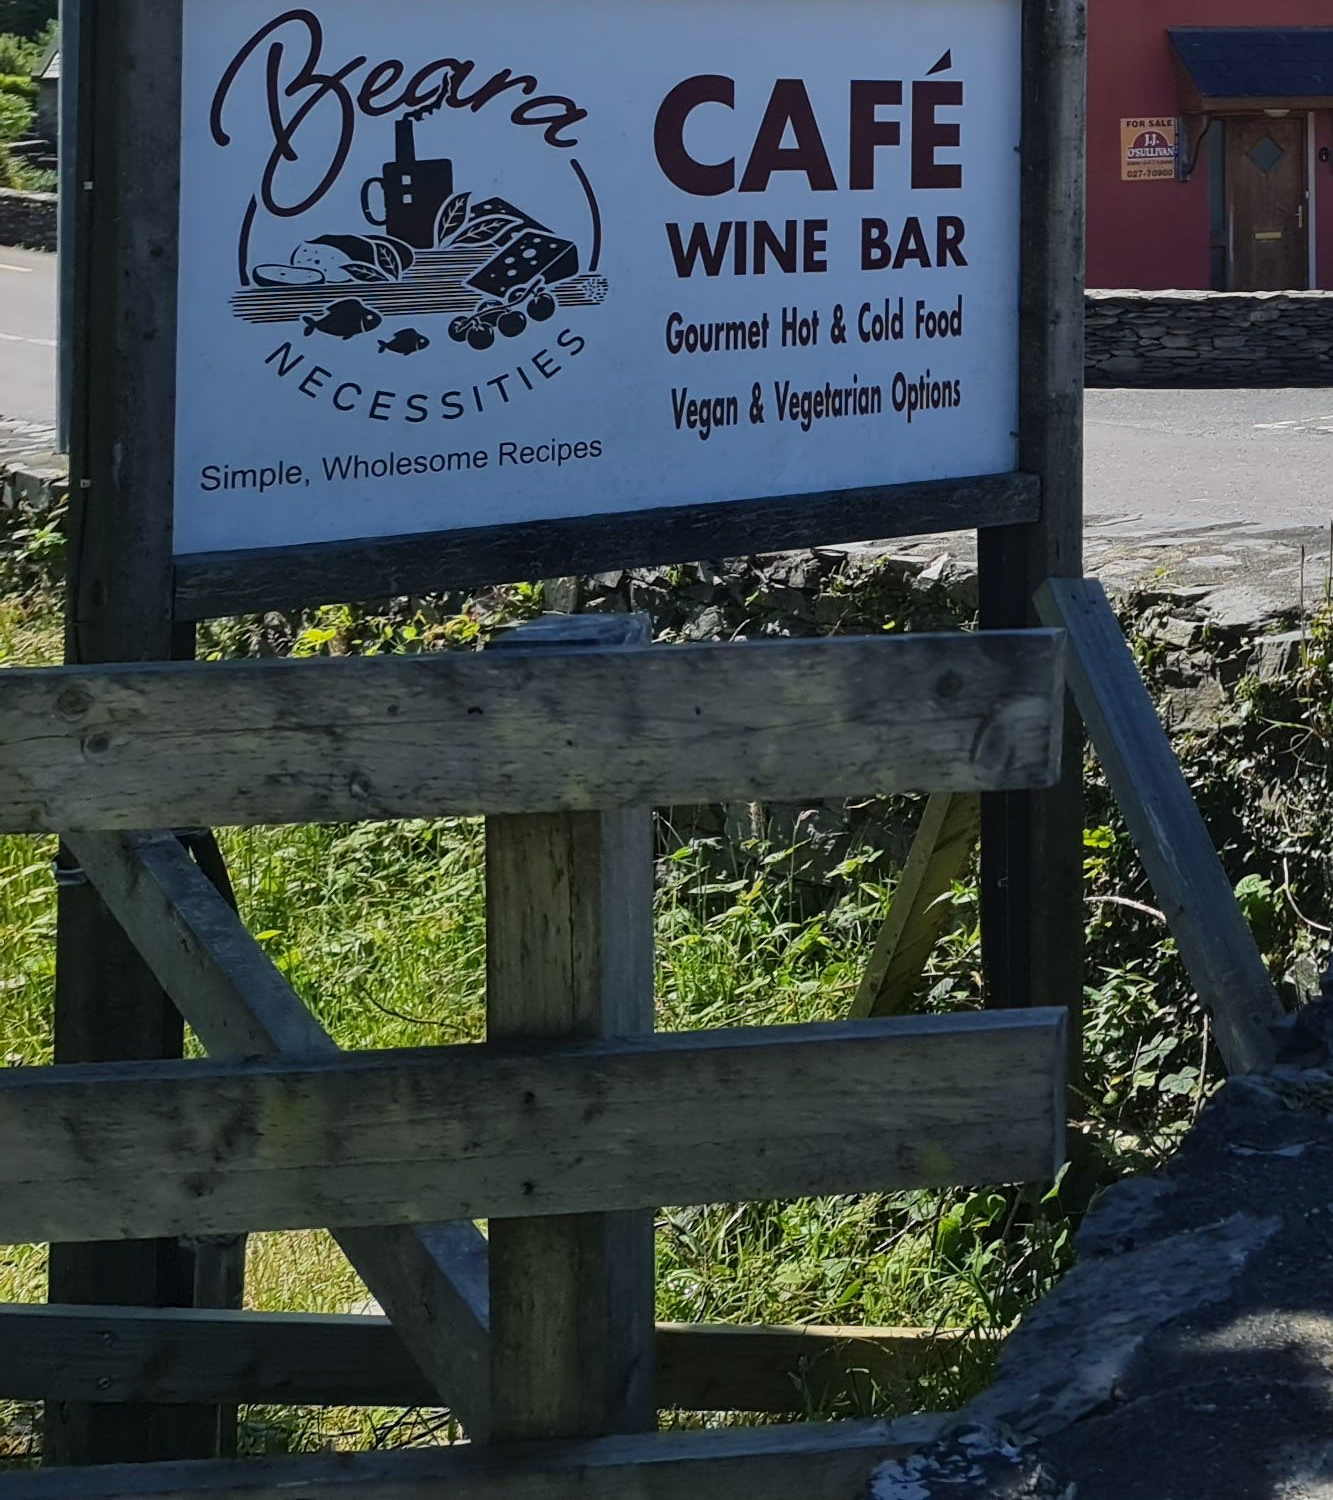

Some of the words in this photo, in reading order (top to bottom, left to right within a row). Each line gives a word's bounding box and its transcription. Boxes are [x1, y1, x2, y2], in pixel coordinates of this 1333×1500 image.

[210, 9, 588, 218] Beara
[653, 48, 964, 197] CAFÉ
[1126, 120, 1146, 128] FOR
[1148, 119, 1173, 127] SALE
[665, 219, 828, 278] WINE
[861, 215, 968, 270] BAR
[665, 311, 770, 354] Gourmet
[781, 306, 819, 347] Hot
[830, 303, 847, 344] &
[858, 297, 903, 343] Cold
[915, 294, 963, 339] Food
[264, 328, 586, 422] NECESSITIES
[671, 387, 738, 441] Vegan
[749, 382, 765, 424] &
[774, 373, 882, 432] Vegetarian
[891, 368, 961, 423] Options
[200, 461, 311, 493] Simple,
[322, 450, 488, 482] Wholesome
[498, 439, 603, 467] Recipes
